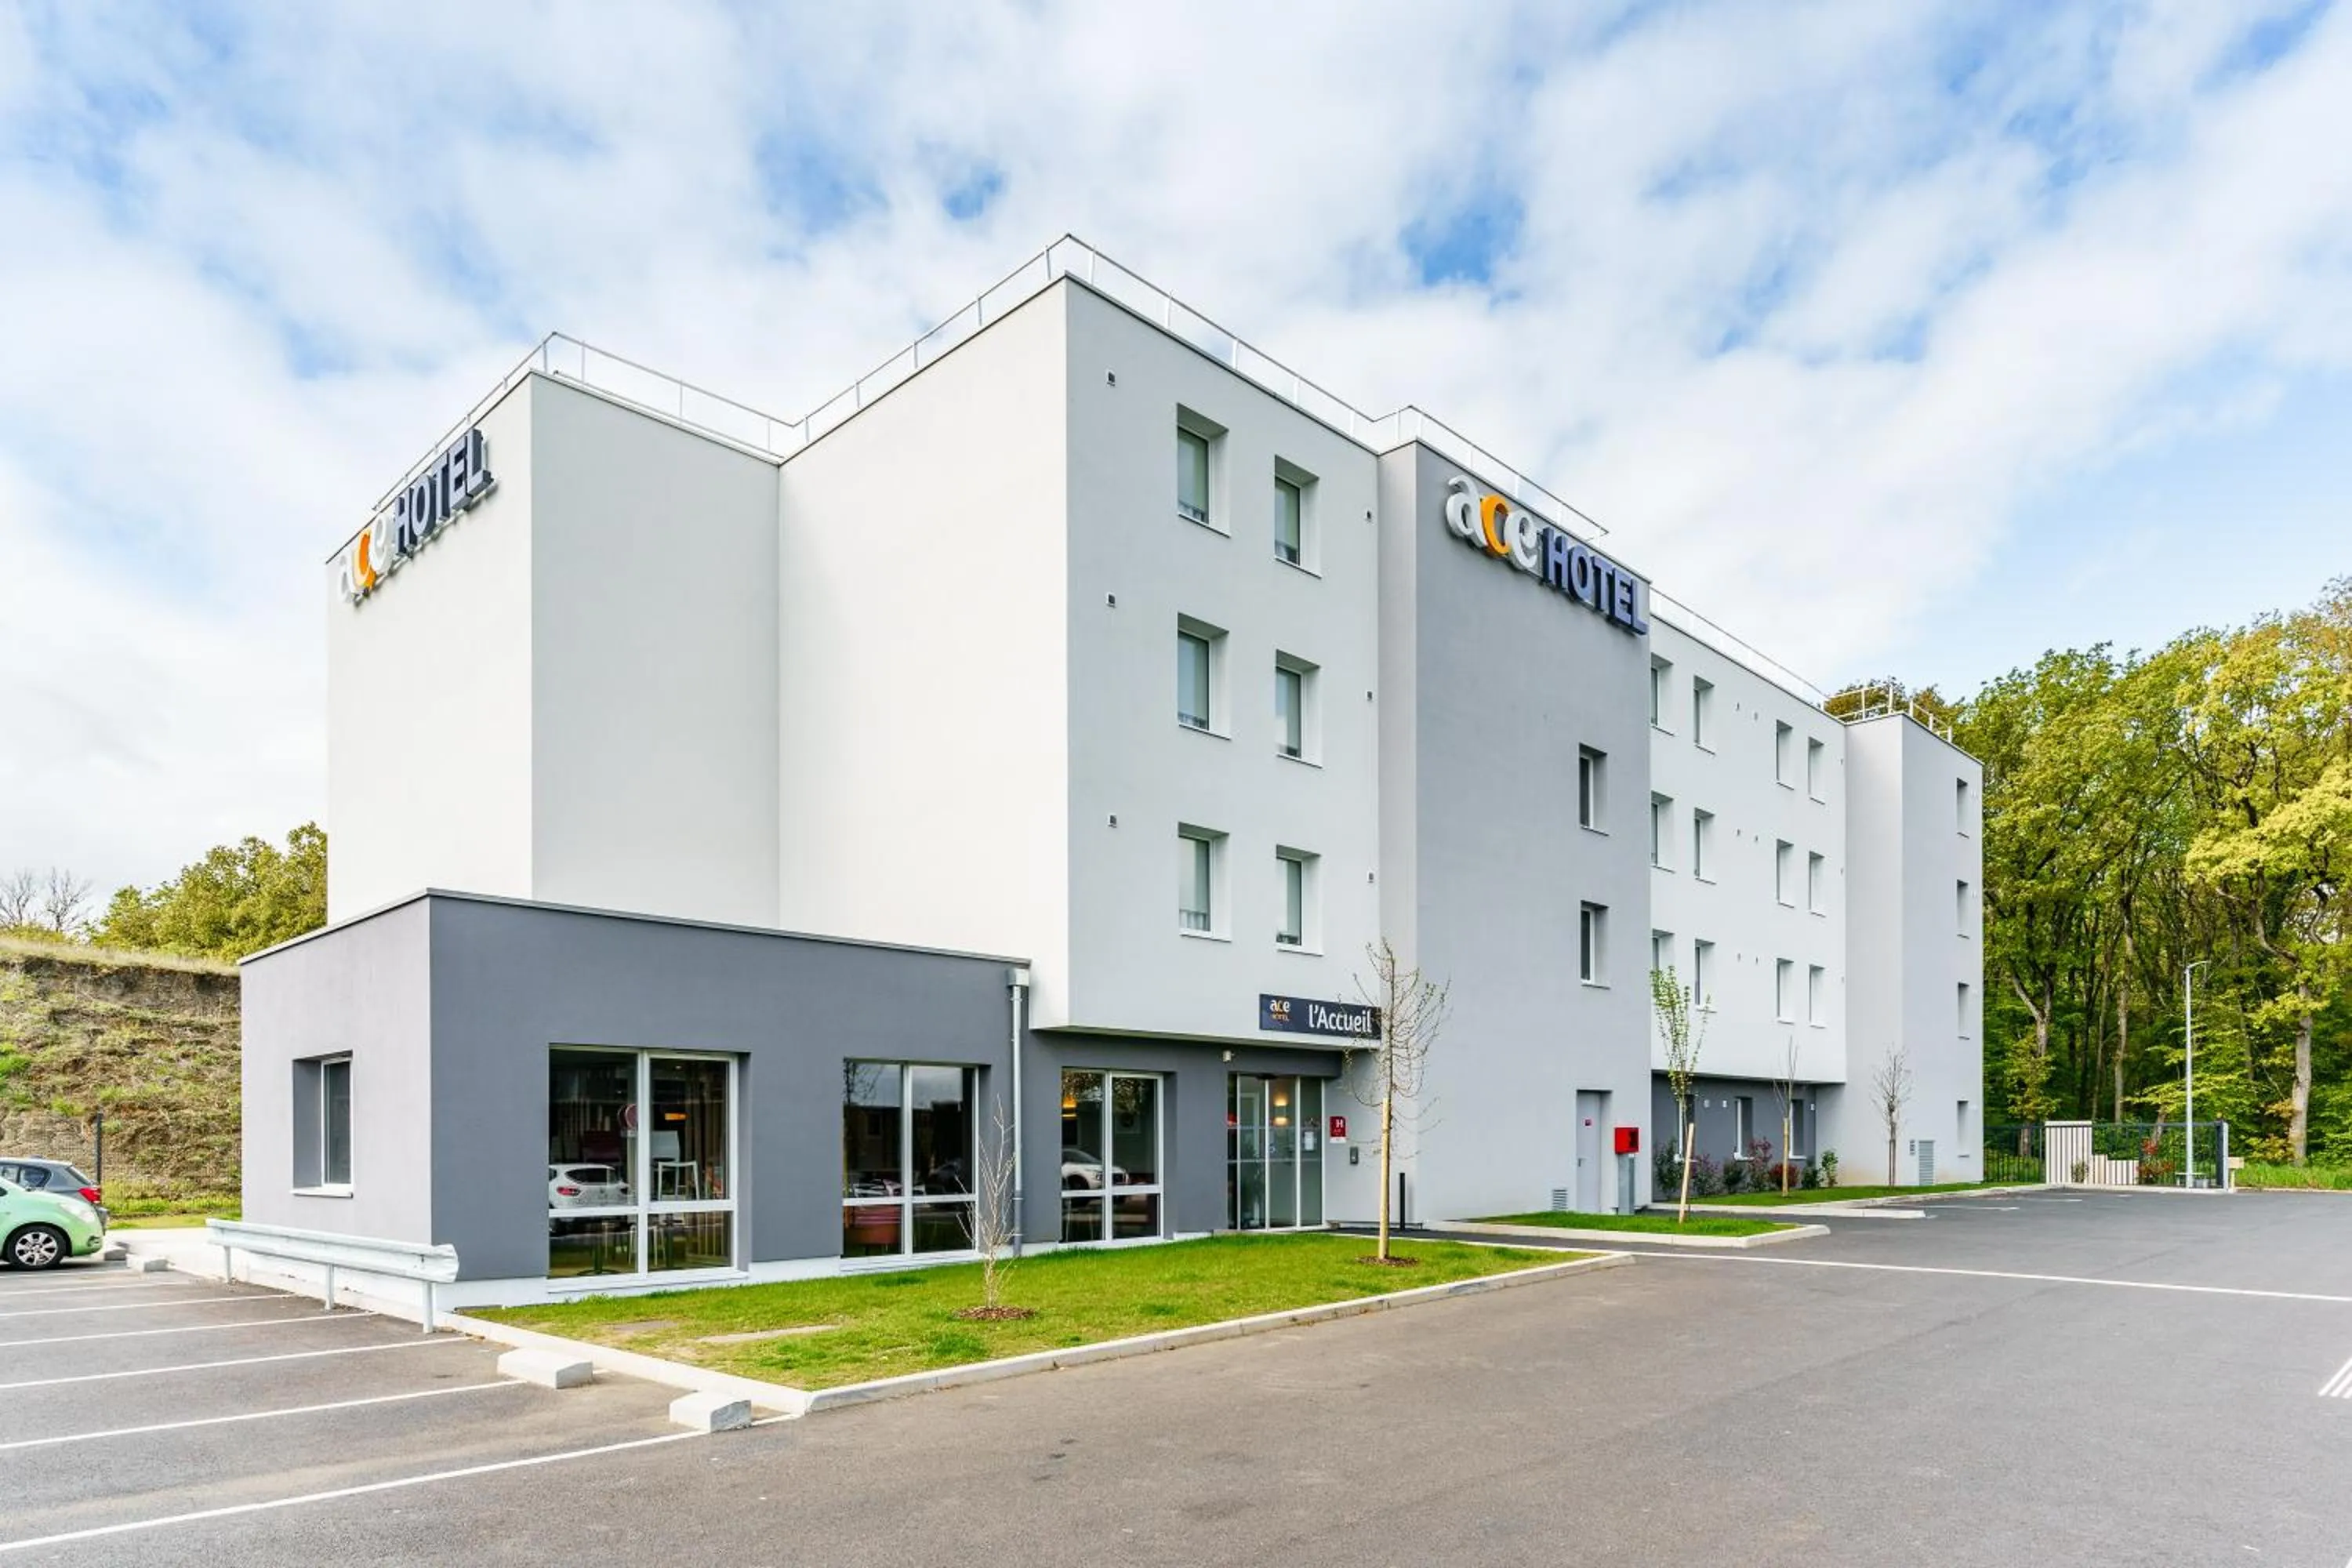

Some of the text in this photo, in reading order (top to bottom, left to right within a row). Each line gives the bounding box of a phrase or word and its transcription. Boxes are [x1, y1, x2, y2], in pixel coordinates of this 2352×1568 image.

[339, 428, 495, 602] ace HOTEL
[1446, 474, 1648, 635] ace HOTEL
[1269, 1000, 1290, 1012] ace
[1308, 1004, 1372, 1033] l'Accueil
